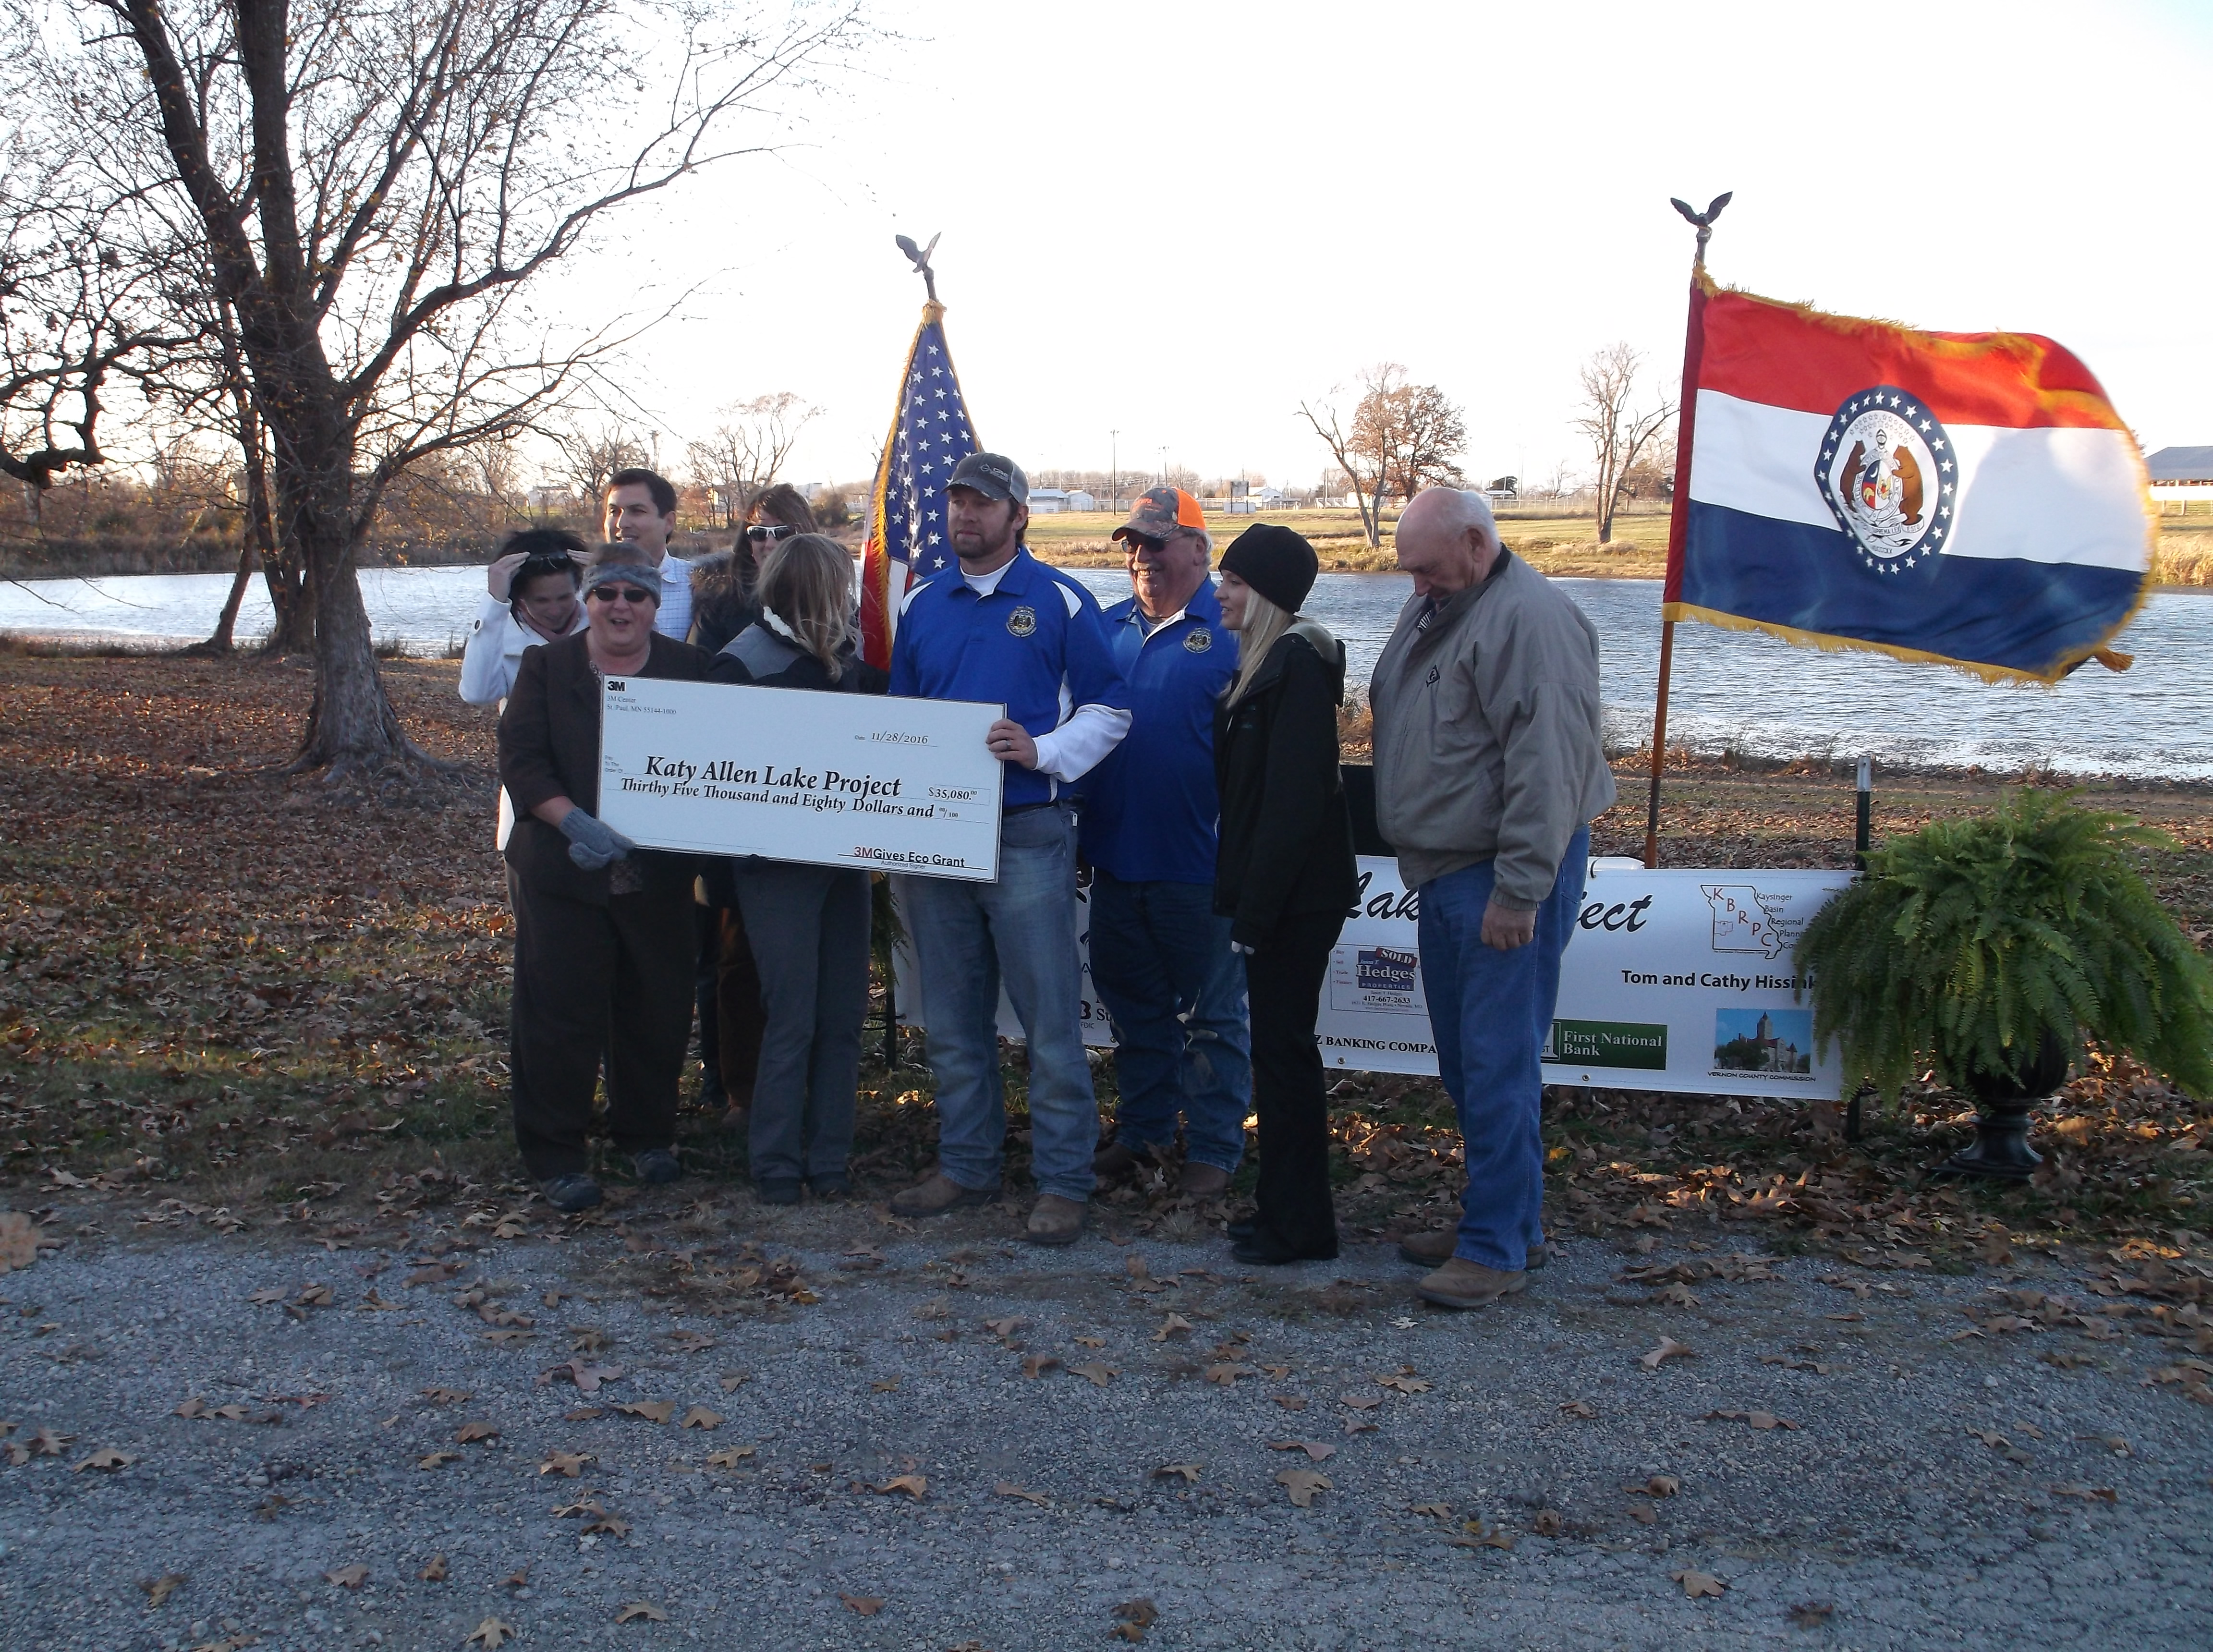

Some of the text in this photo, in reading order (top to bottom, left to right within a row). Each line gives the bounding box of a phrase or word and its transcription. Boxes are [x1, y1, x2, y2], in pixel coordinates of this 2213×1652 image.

[608, 680, 625, 692] 3M
[871, 730, 928, 744] 11/28/2016
[645, 756, 902, 800] Katy Allen Lake Project
[621, 778, 669, 797] Thirthy
[672, 782, 699, 796] Five
[704, 785, 769, 802] Thousand
[772, 792, 800, 805] and
[802, 794, 846, 813] Eighty
[852, 798, 903, 814] Dollars
[907, 804, 935, 817] and
[854, 846, 965, 867] 3MGives Eco Grant
[909, 861, 926, 870] Signer
[1756, 893, 1792, 902] Kaysinger
[1713, 887, 1772, 947] K B R P C
[1771, 917, 1803, 925] Regional
[1381, 949, 1412, 965] SOLD
[1356, 964, 1416, 983] Hedges
[1621, 970, 1658, 984] Tom
[1663, 972, 1696, 986] and
[1700, 973, 1751, 992] Cathy
[1363, 995, 1410, 1004] 417-667-2633
[1325, 1036, 1385, 1050] BANKING
[1564, 1030, 1663, 1047] First National
[1564, 1043, 1601, 1057] Bank
